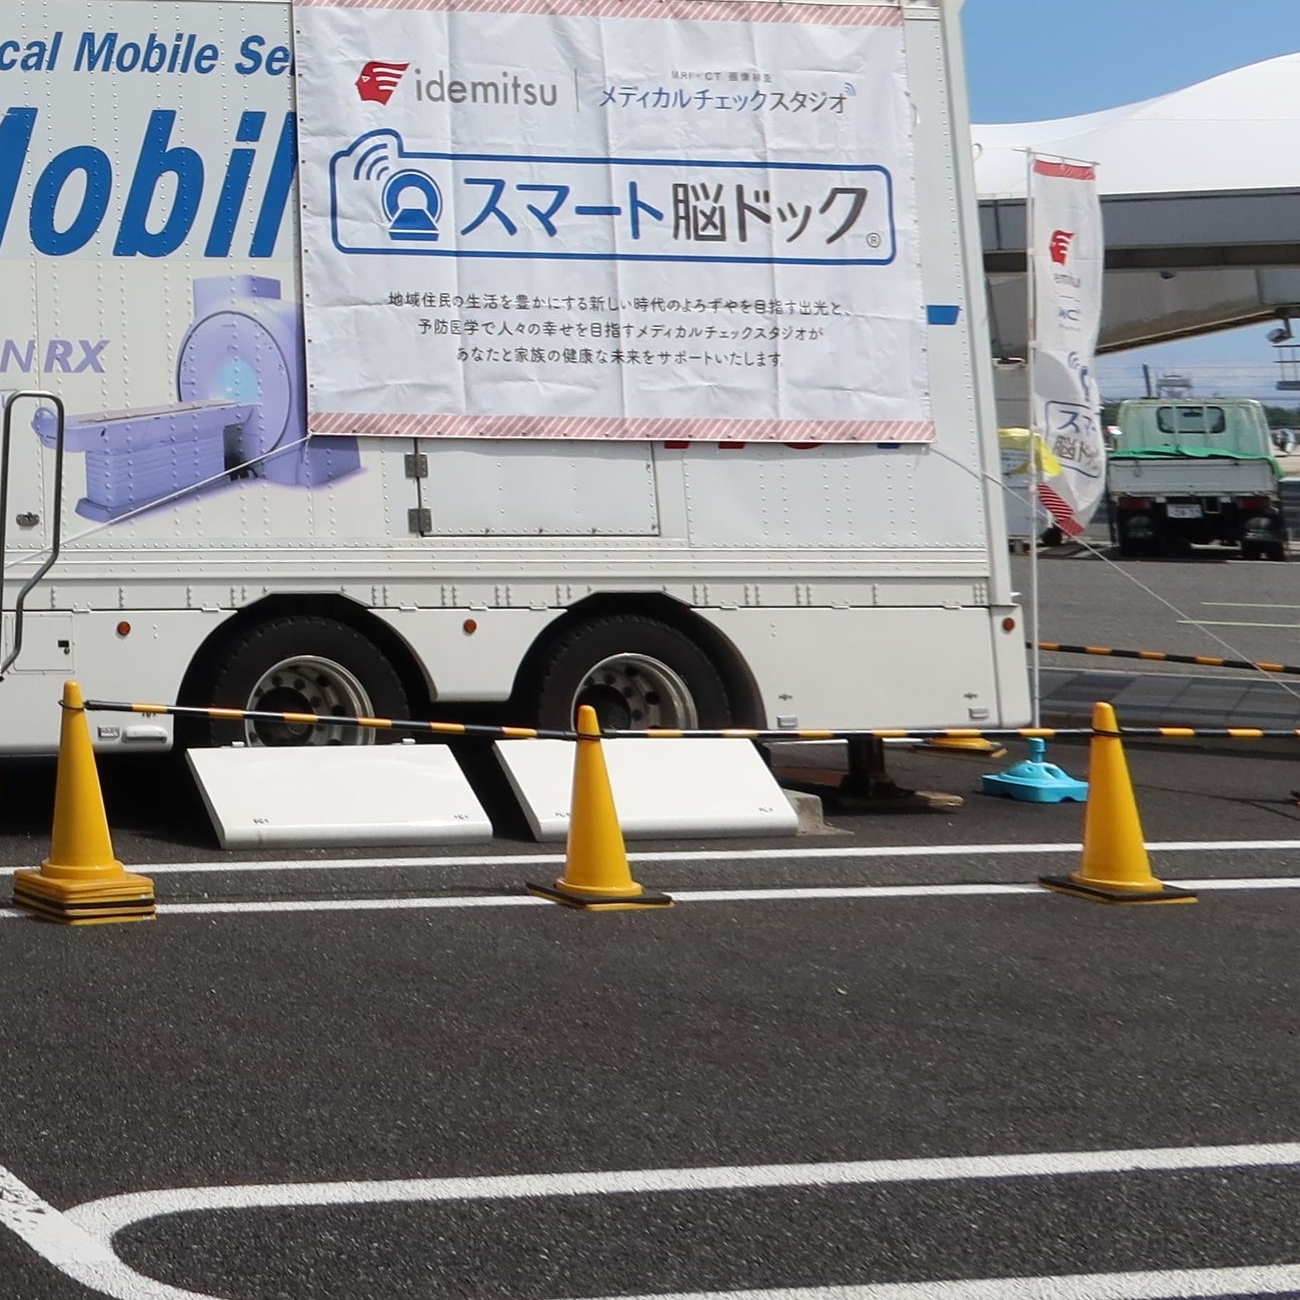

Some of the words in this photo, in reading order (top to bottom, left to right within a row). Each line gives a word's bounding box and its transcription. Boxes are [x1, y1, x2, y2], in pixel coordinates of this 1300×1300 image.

[73, 32, 218, 74] Mobile
[234, 34, 295, 76] Se
[414, 69, 558, 106] idemitsu
[599, 85, 847, 114] メディカルチェックスタジオ
[460, 176, 868, 245] スマート脳ドック
[43, 339, 111, 374] RX
